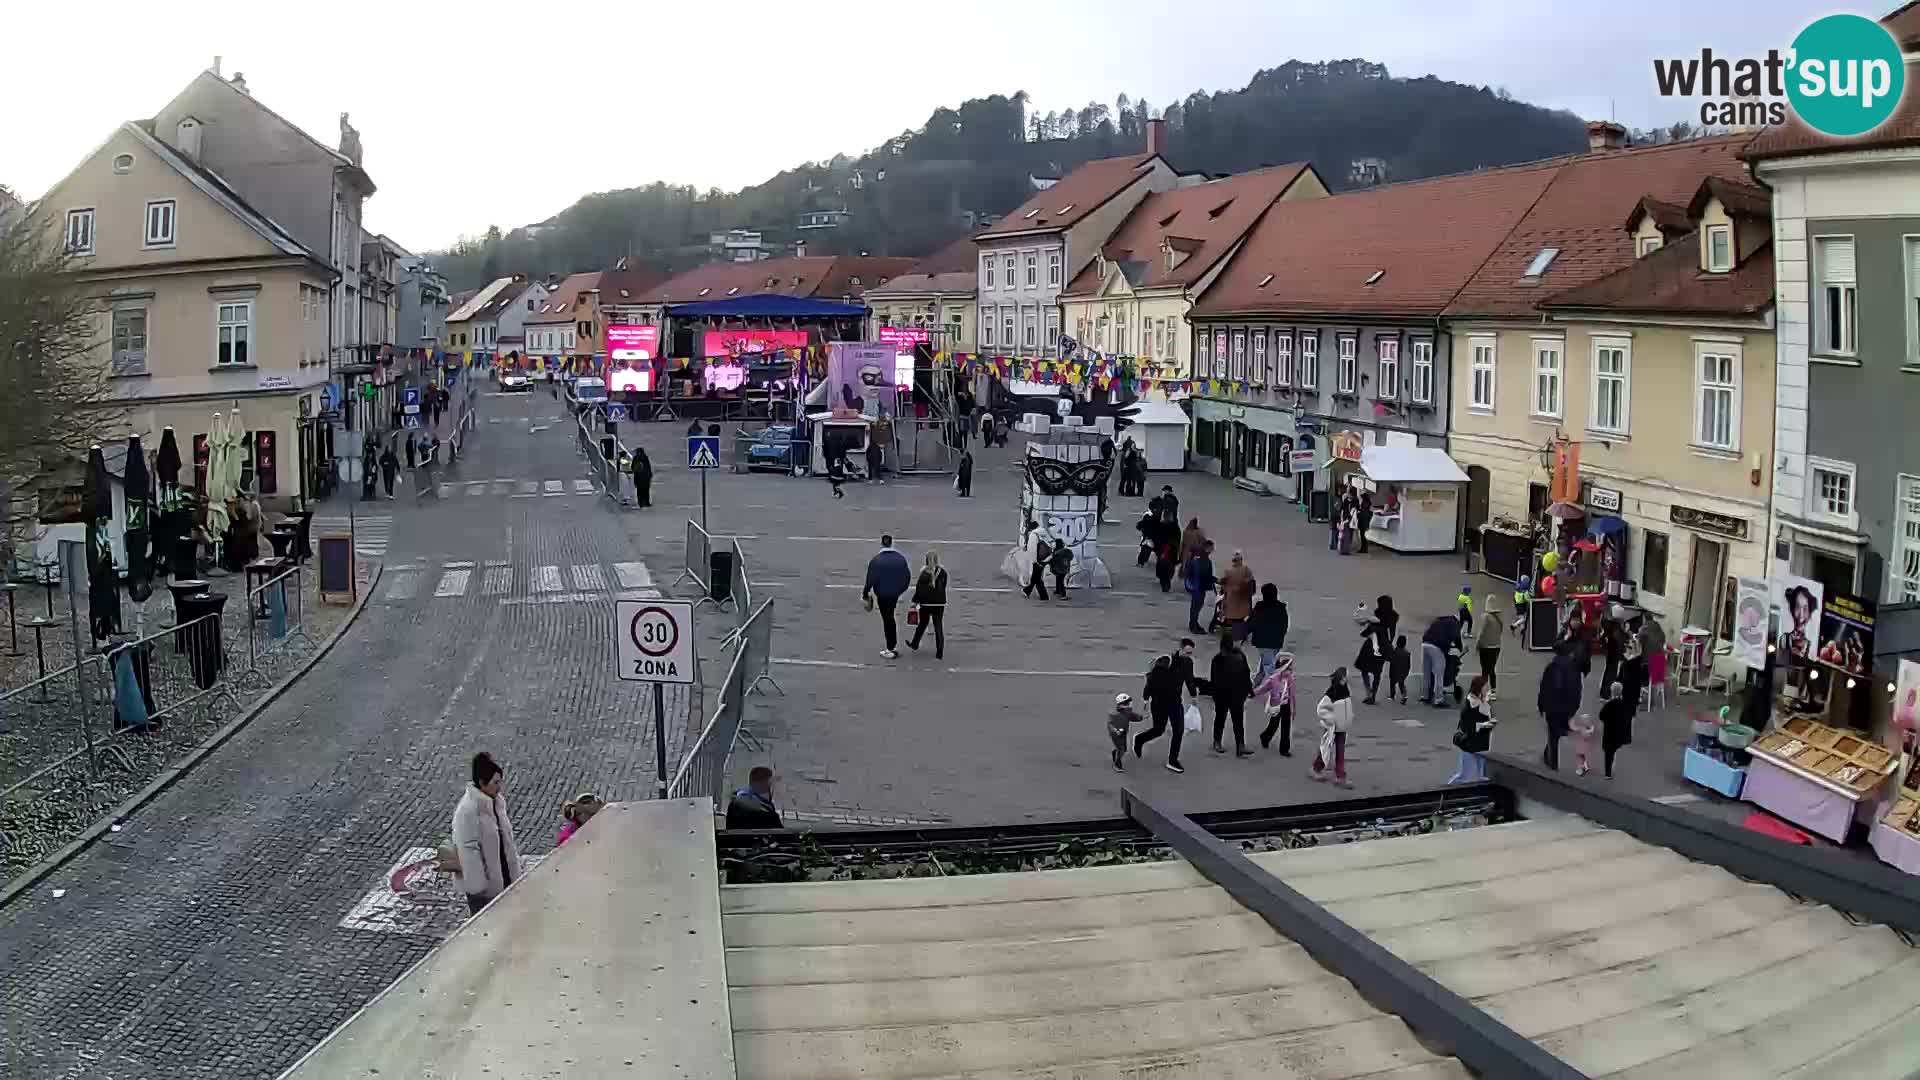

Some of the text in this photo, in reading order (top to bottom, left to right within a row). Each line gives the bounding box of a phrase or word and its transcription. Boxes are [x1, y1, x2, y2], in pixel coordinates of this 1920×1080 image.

[408, 392, 415, 402] P
[643, 622, 667, 643] 30
[633, 659, 678, 676] ZONA
